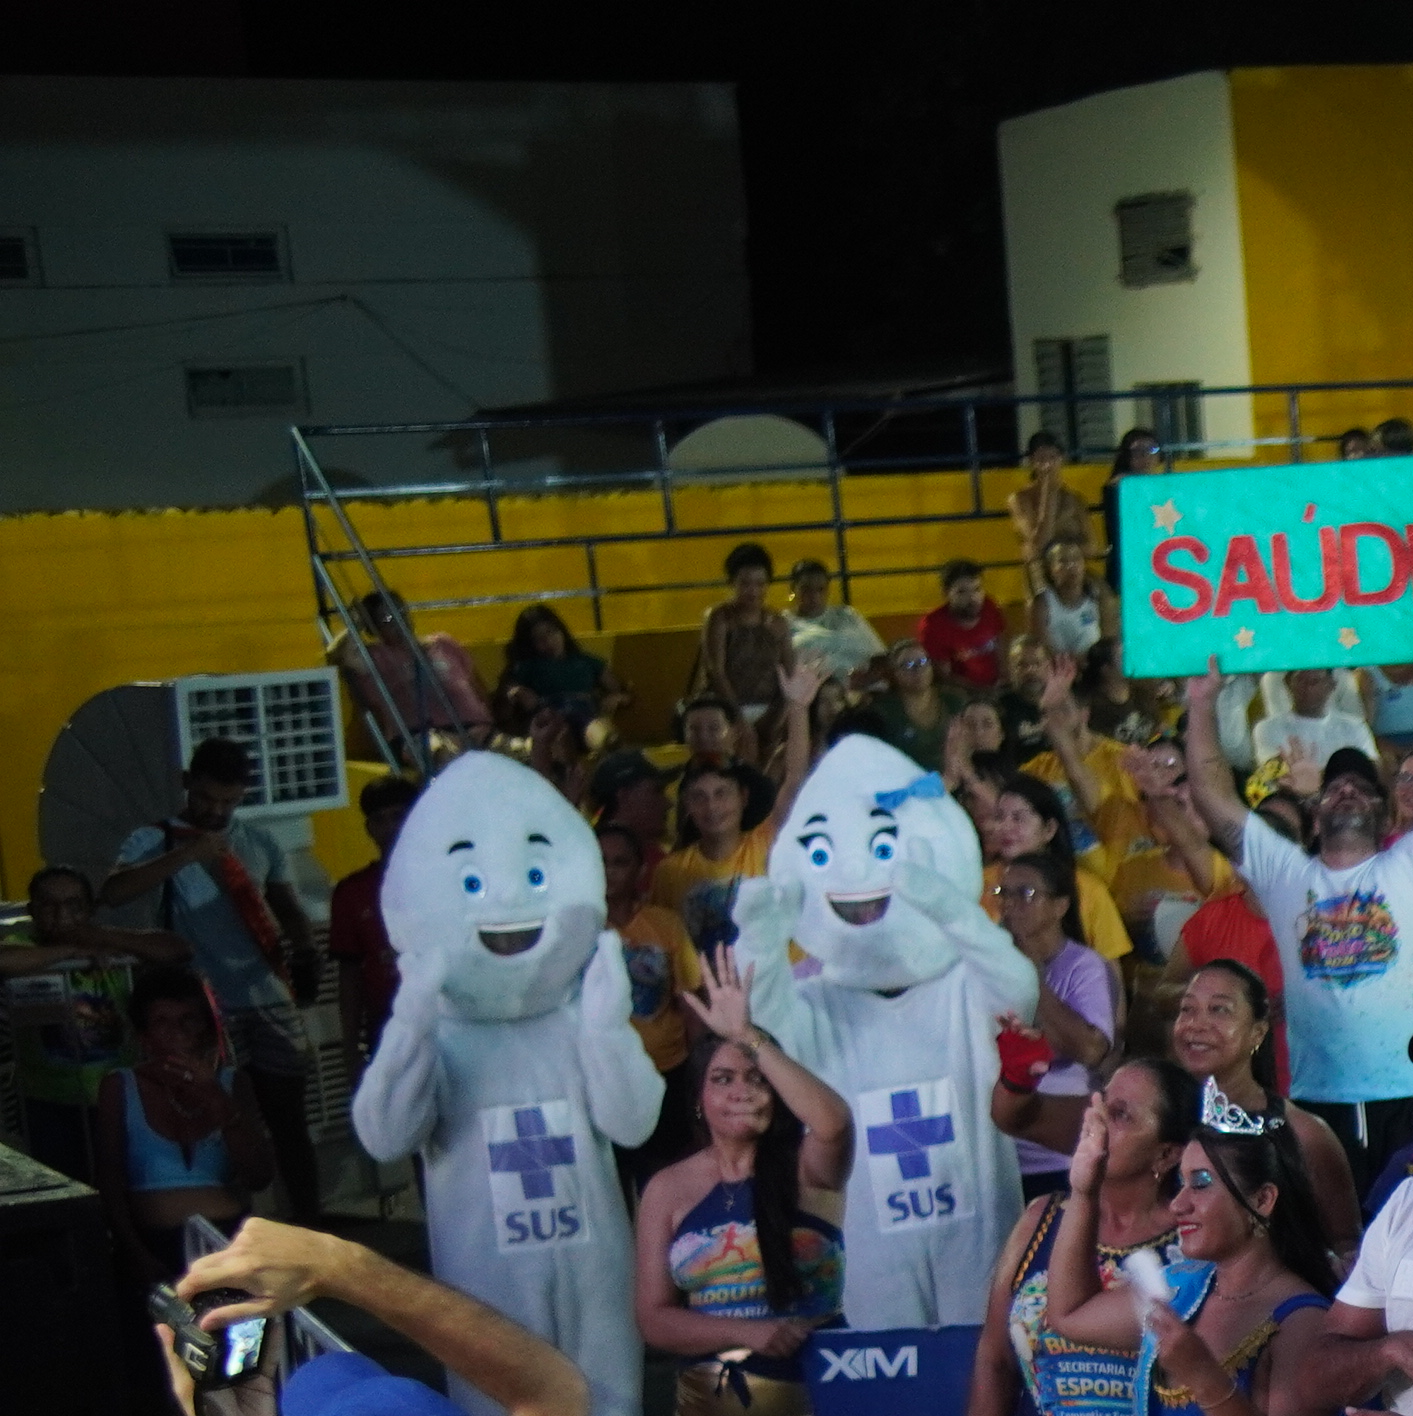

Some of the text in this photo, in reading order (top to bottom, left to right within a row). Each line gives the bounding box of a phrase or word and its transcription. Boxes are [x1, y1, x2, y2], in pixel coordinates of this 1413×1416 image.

[887, 1183, 957, 1223] SUS
[505, 1204, 580, 1244] SUS
[1058, 1361, 1125, 1376] SECRETARIA
